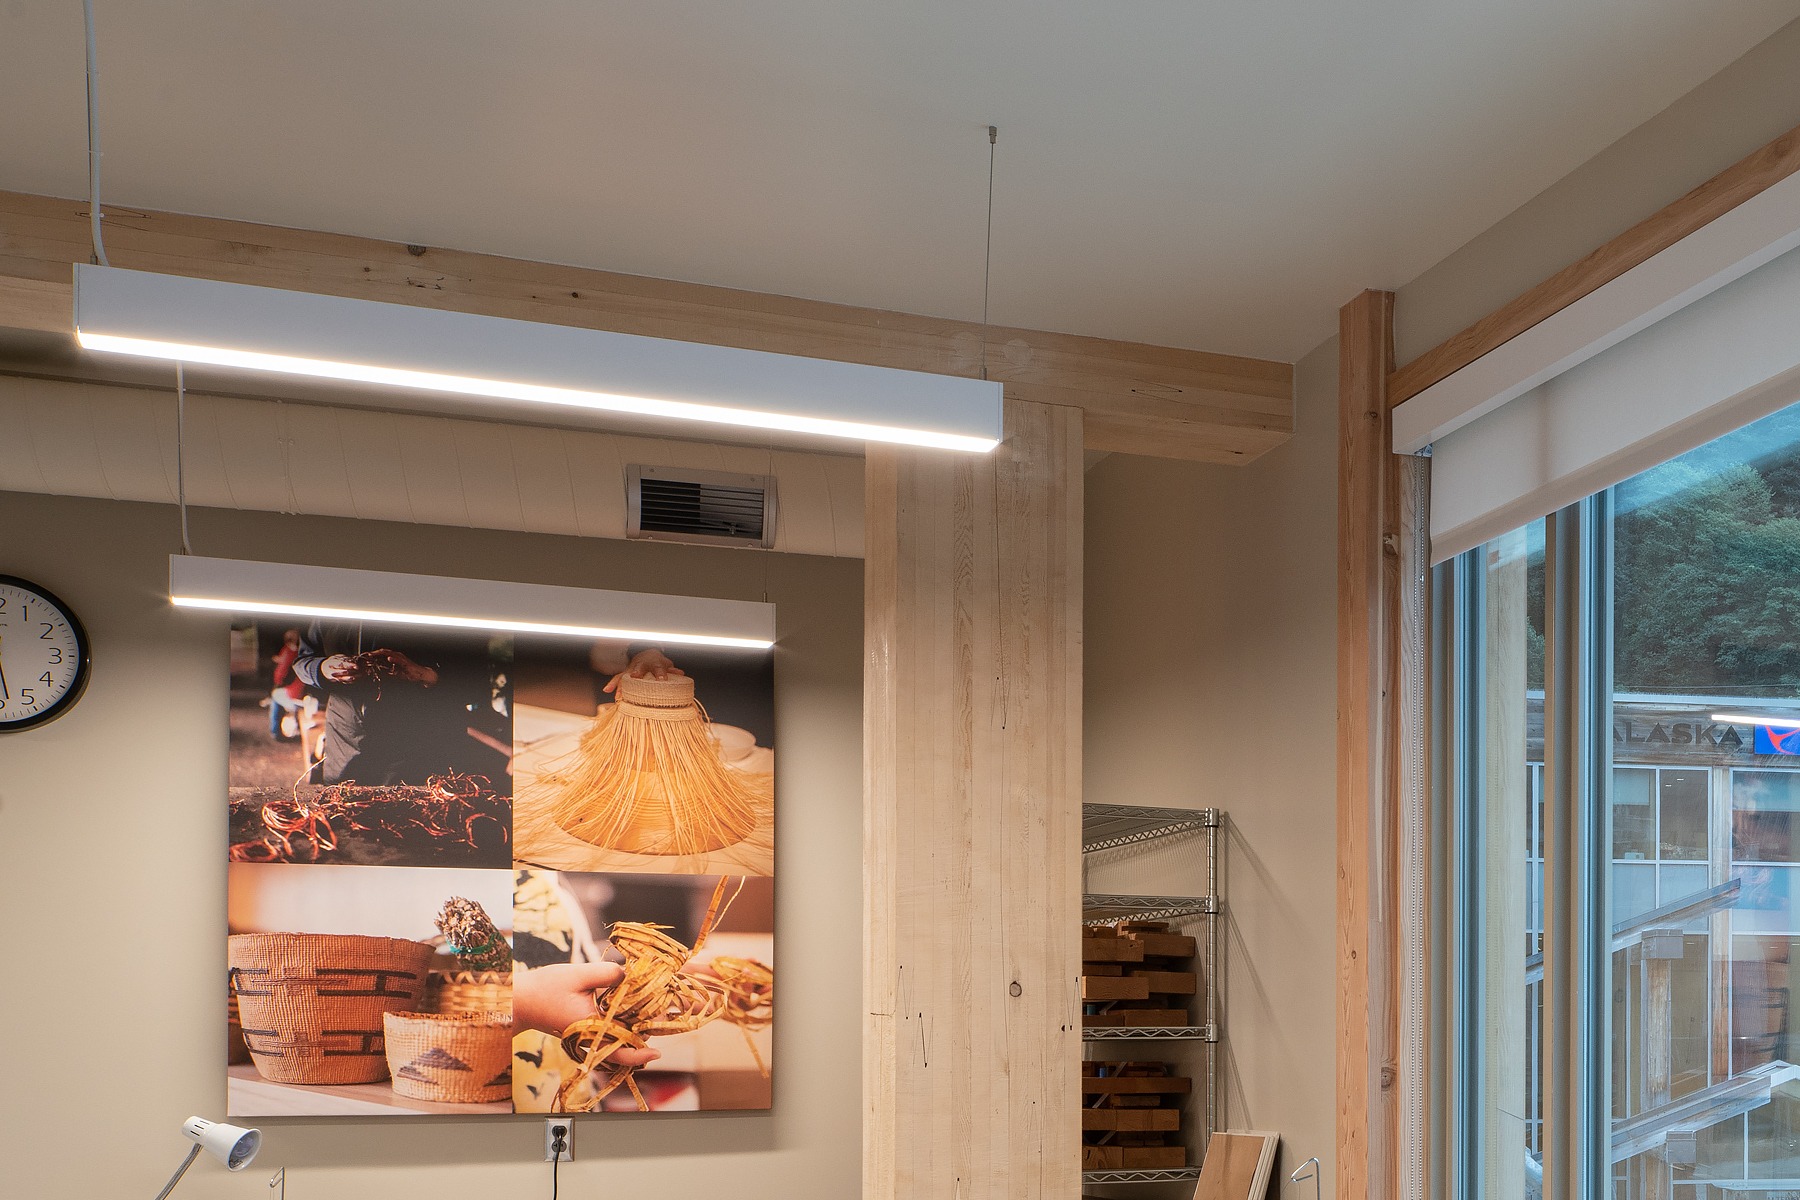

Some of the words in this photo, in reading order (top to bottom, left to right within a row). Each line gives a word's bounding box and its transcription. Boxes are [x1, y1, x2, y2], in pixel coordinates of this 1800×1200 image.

[22, 605, 28, 622] 1
[40, 623, 54, 640] 2
[48, 647, 62, 665] 3
[39, 671, 54, 687] 4
[21, 688, 35, 705] 5
